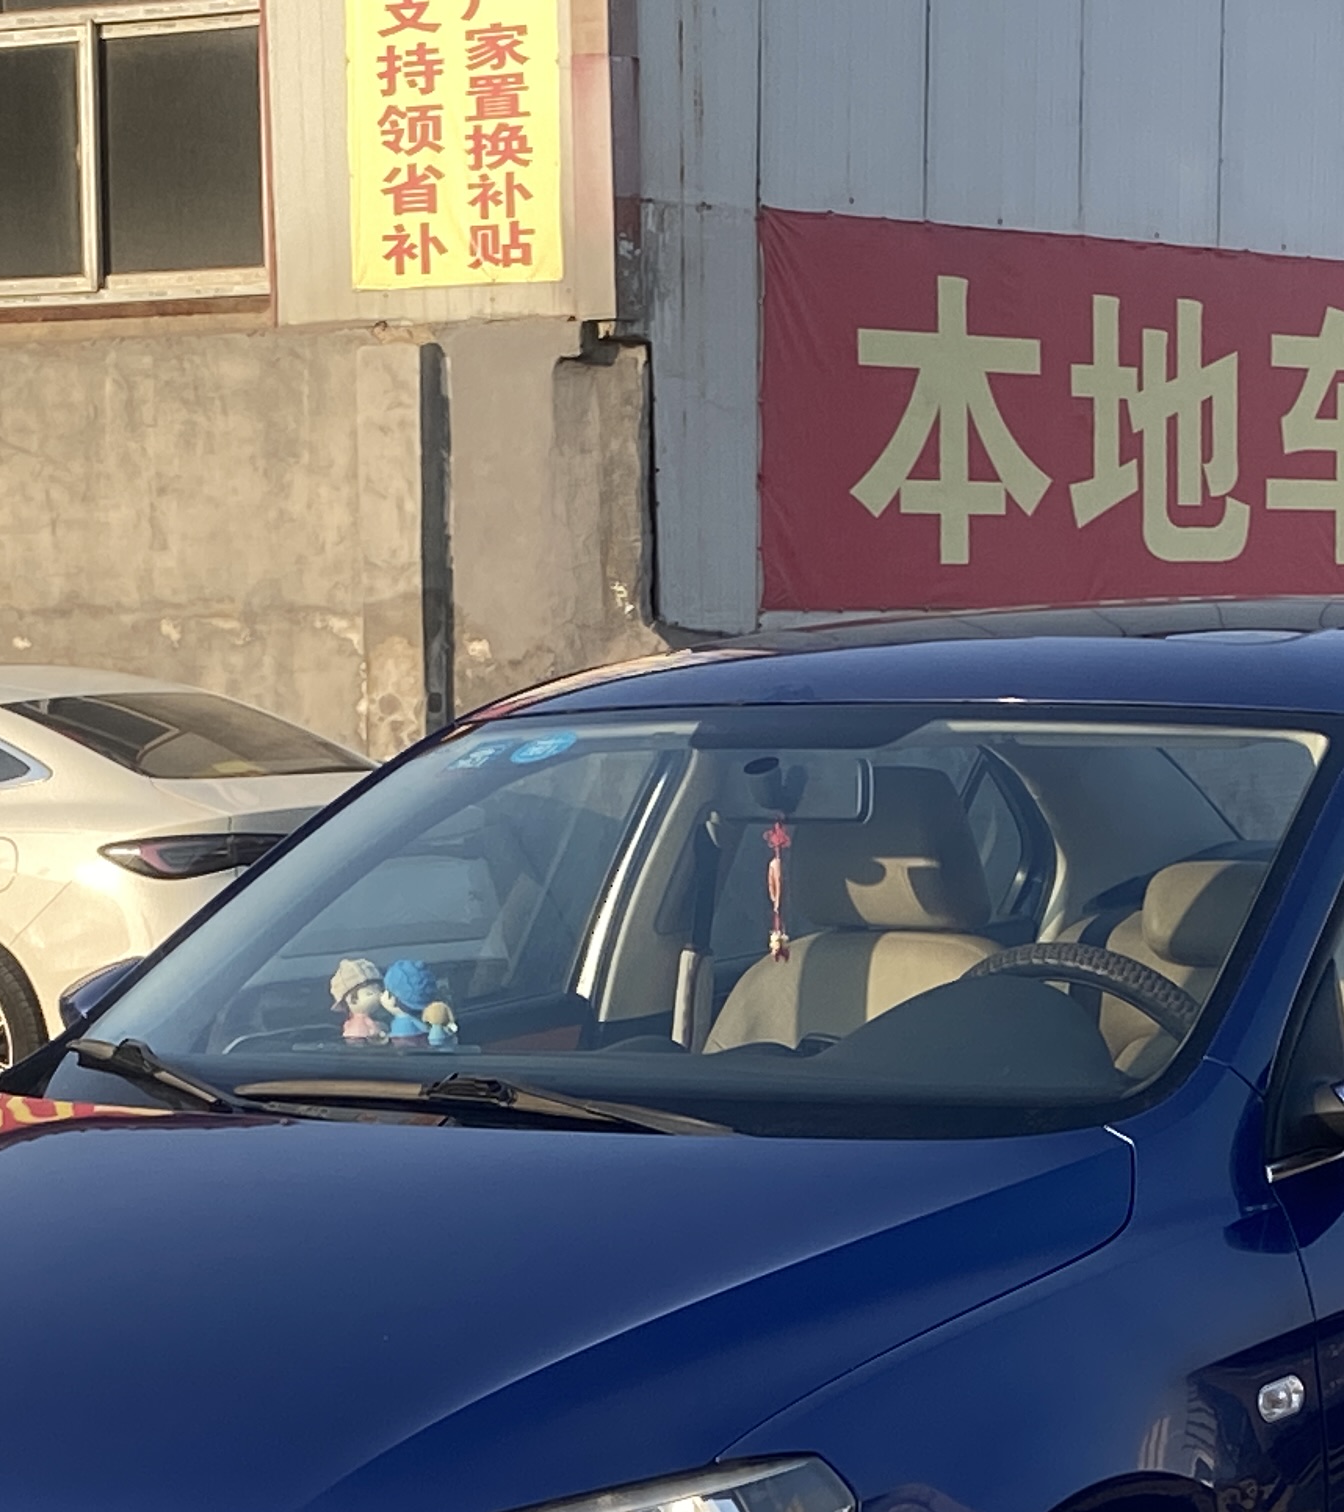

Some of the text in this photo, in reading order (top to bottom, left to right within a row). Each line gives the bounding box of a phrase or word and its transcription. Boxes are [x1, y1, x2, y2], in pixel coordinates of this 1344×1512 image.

[376, 0, 449, 276] 支持领省补
